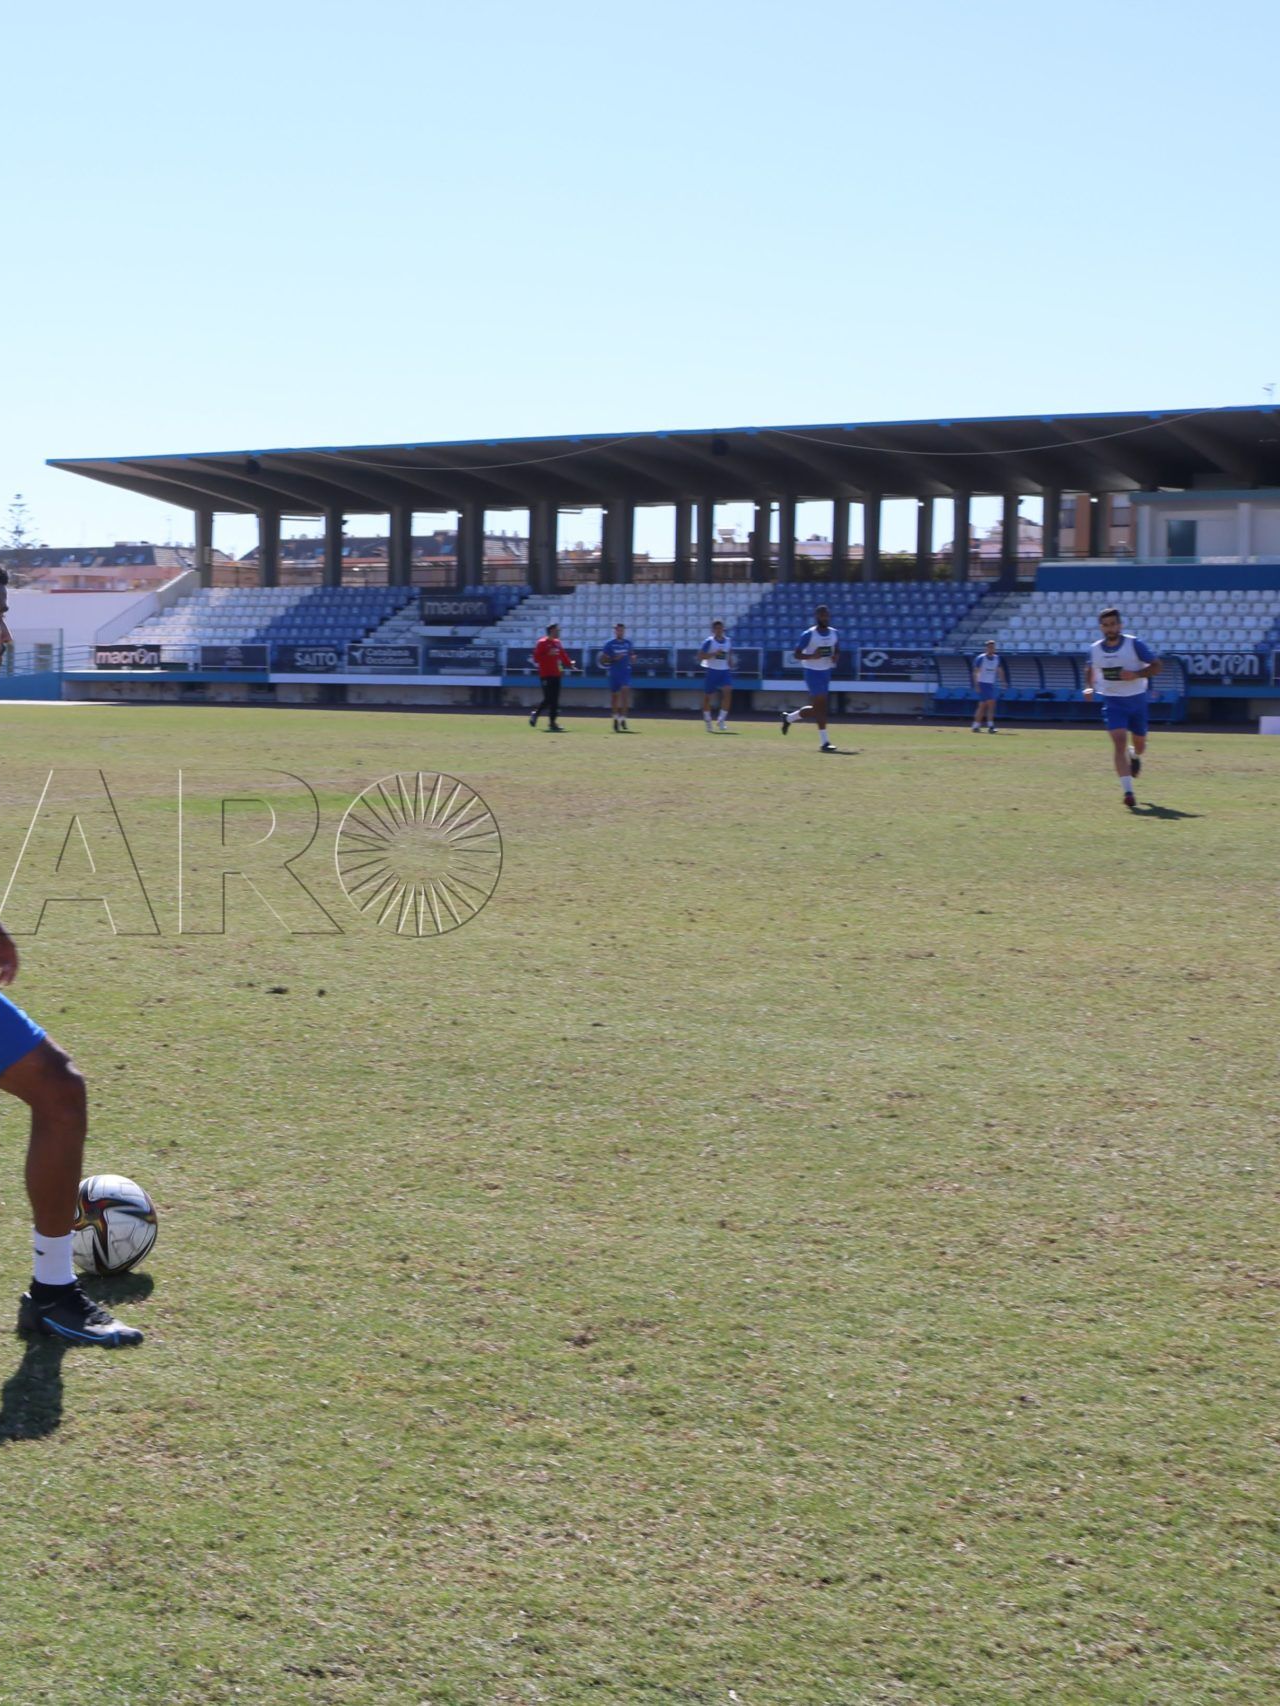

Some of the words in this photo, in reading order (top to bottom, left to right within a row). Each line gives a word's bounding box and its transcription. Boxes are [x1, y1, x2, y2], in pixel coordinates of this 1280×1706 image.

[424, 602, 486, 615] macron
[96, 648, 158, 664] macron
[294, 652, 337, 666] SAITO
